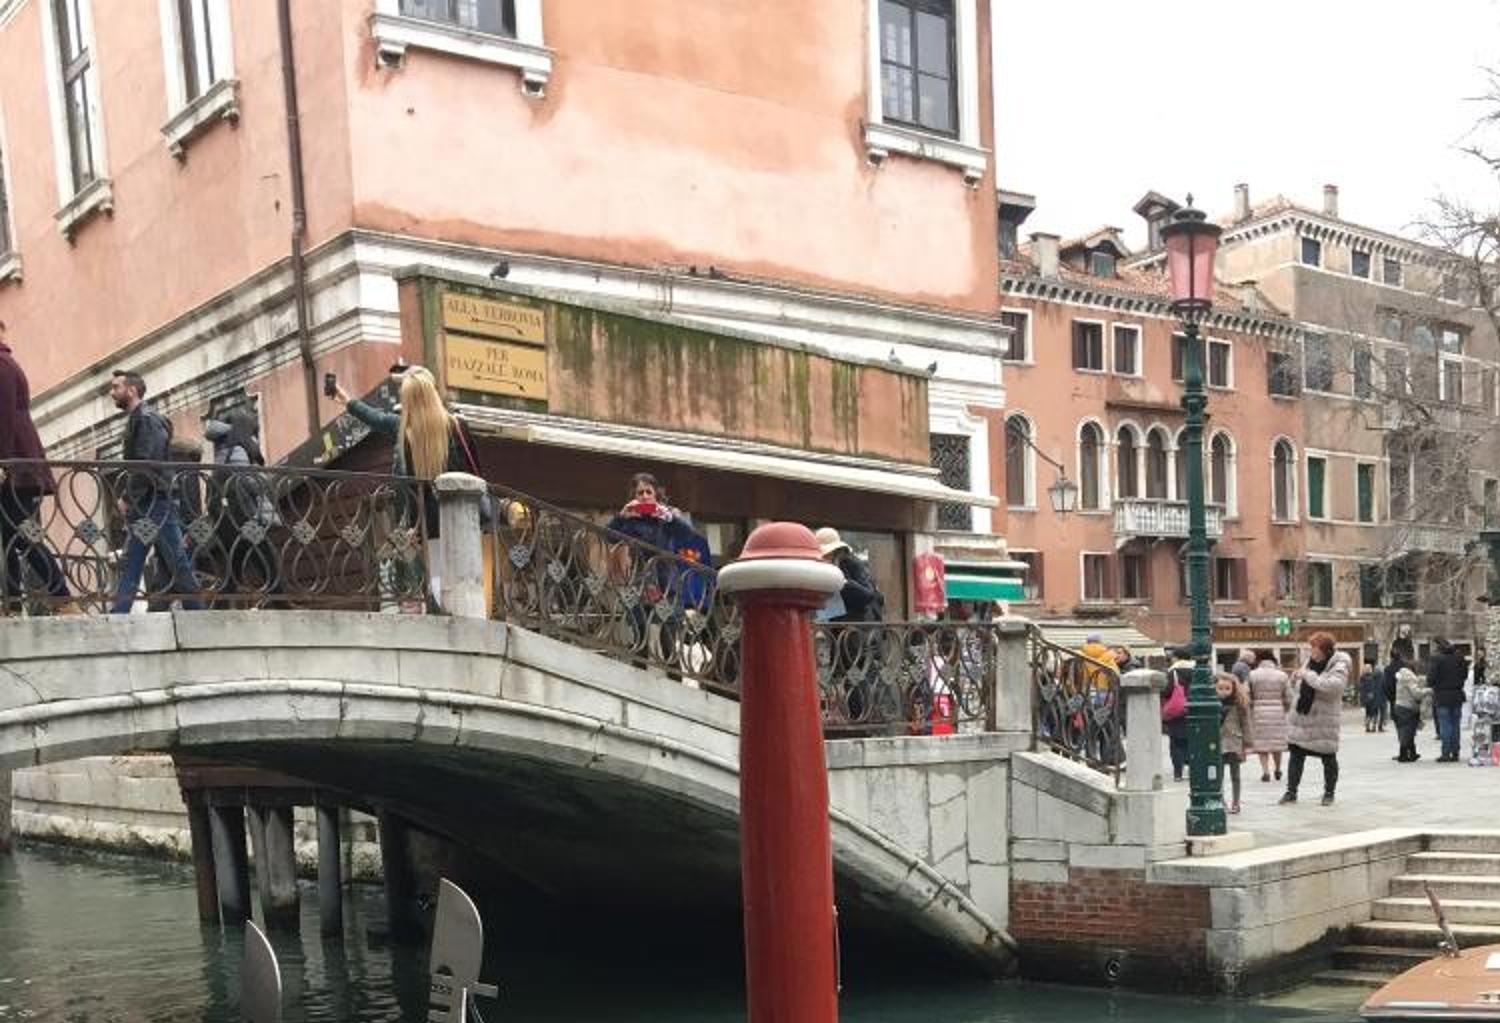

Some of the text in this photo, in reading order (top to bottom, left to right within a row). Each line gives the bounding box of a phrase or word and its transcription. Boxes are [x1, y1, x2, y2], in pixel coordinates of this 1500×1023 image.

[448, 298, 542, 328] ALLA FERROVIA
[449, 354, 545, 383] PIAZZALE ROMA
[486, 346, 510, 362] PER
